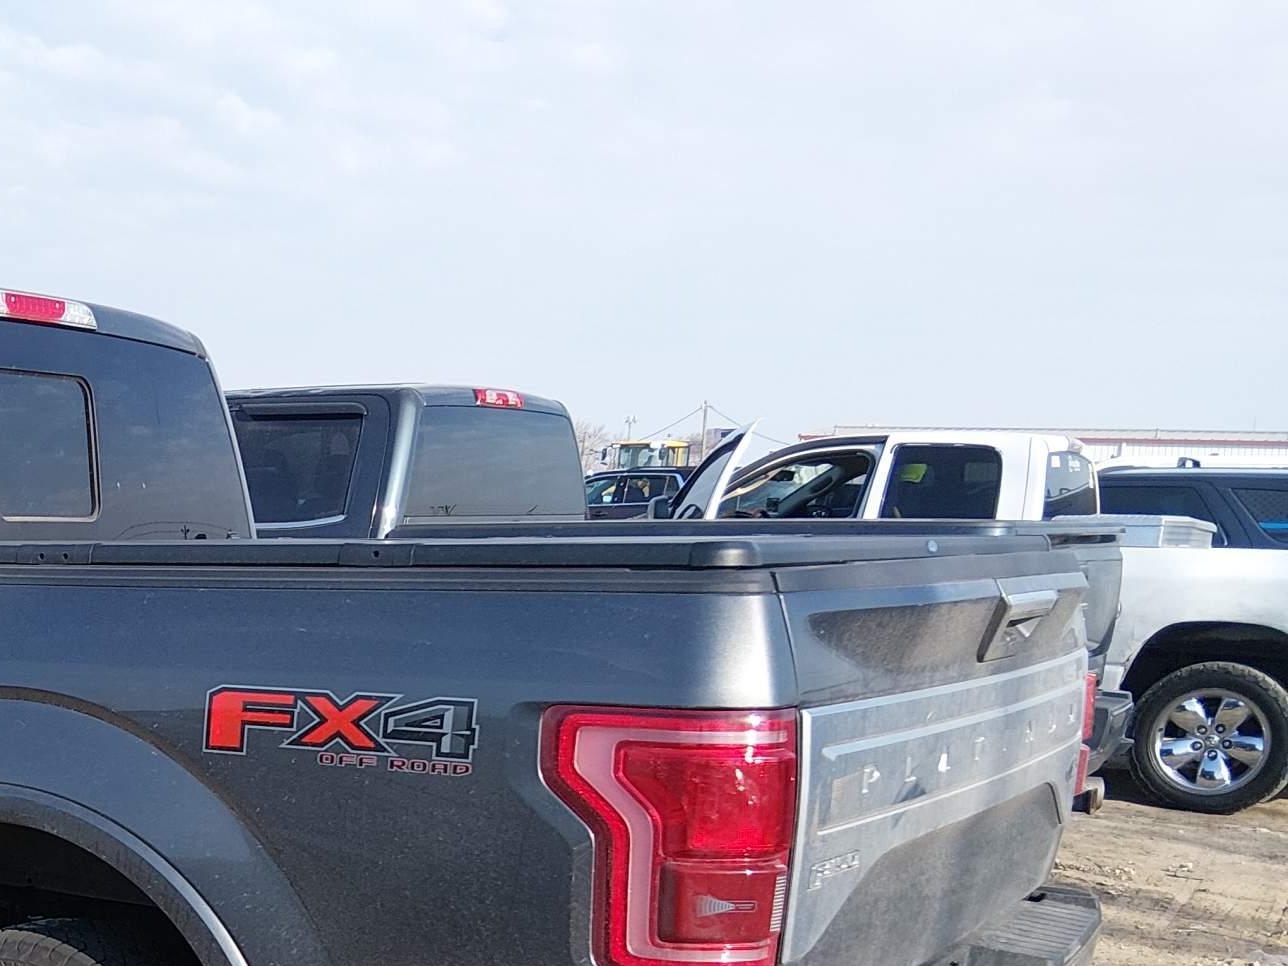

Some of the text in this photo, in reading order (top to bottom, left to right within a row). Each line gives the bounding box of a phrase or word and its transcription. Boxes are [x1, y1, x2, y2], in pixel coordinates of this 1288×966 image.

[203, 685, 478, 761] FX4
[317, 752, 472, 776] OFF ROAD
